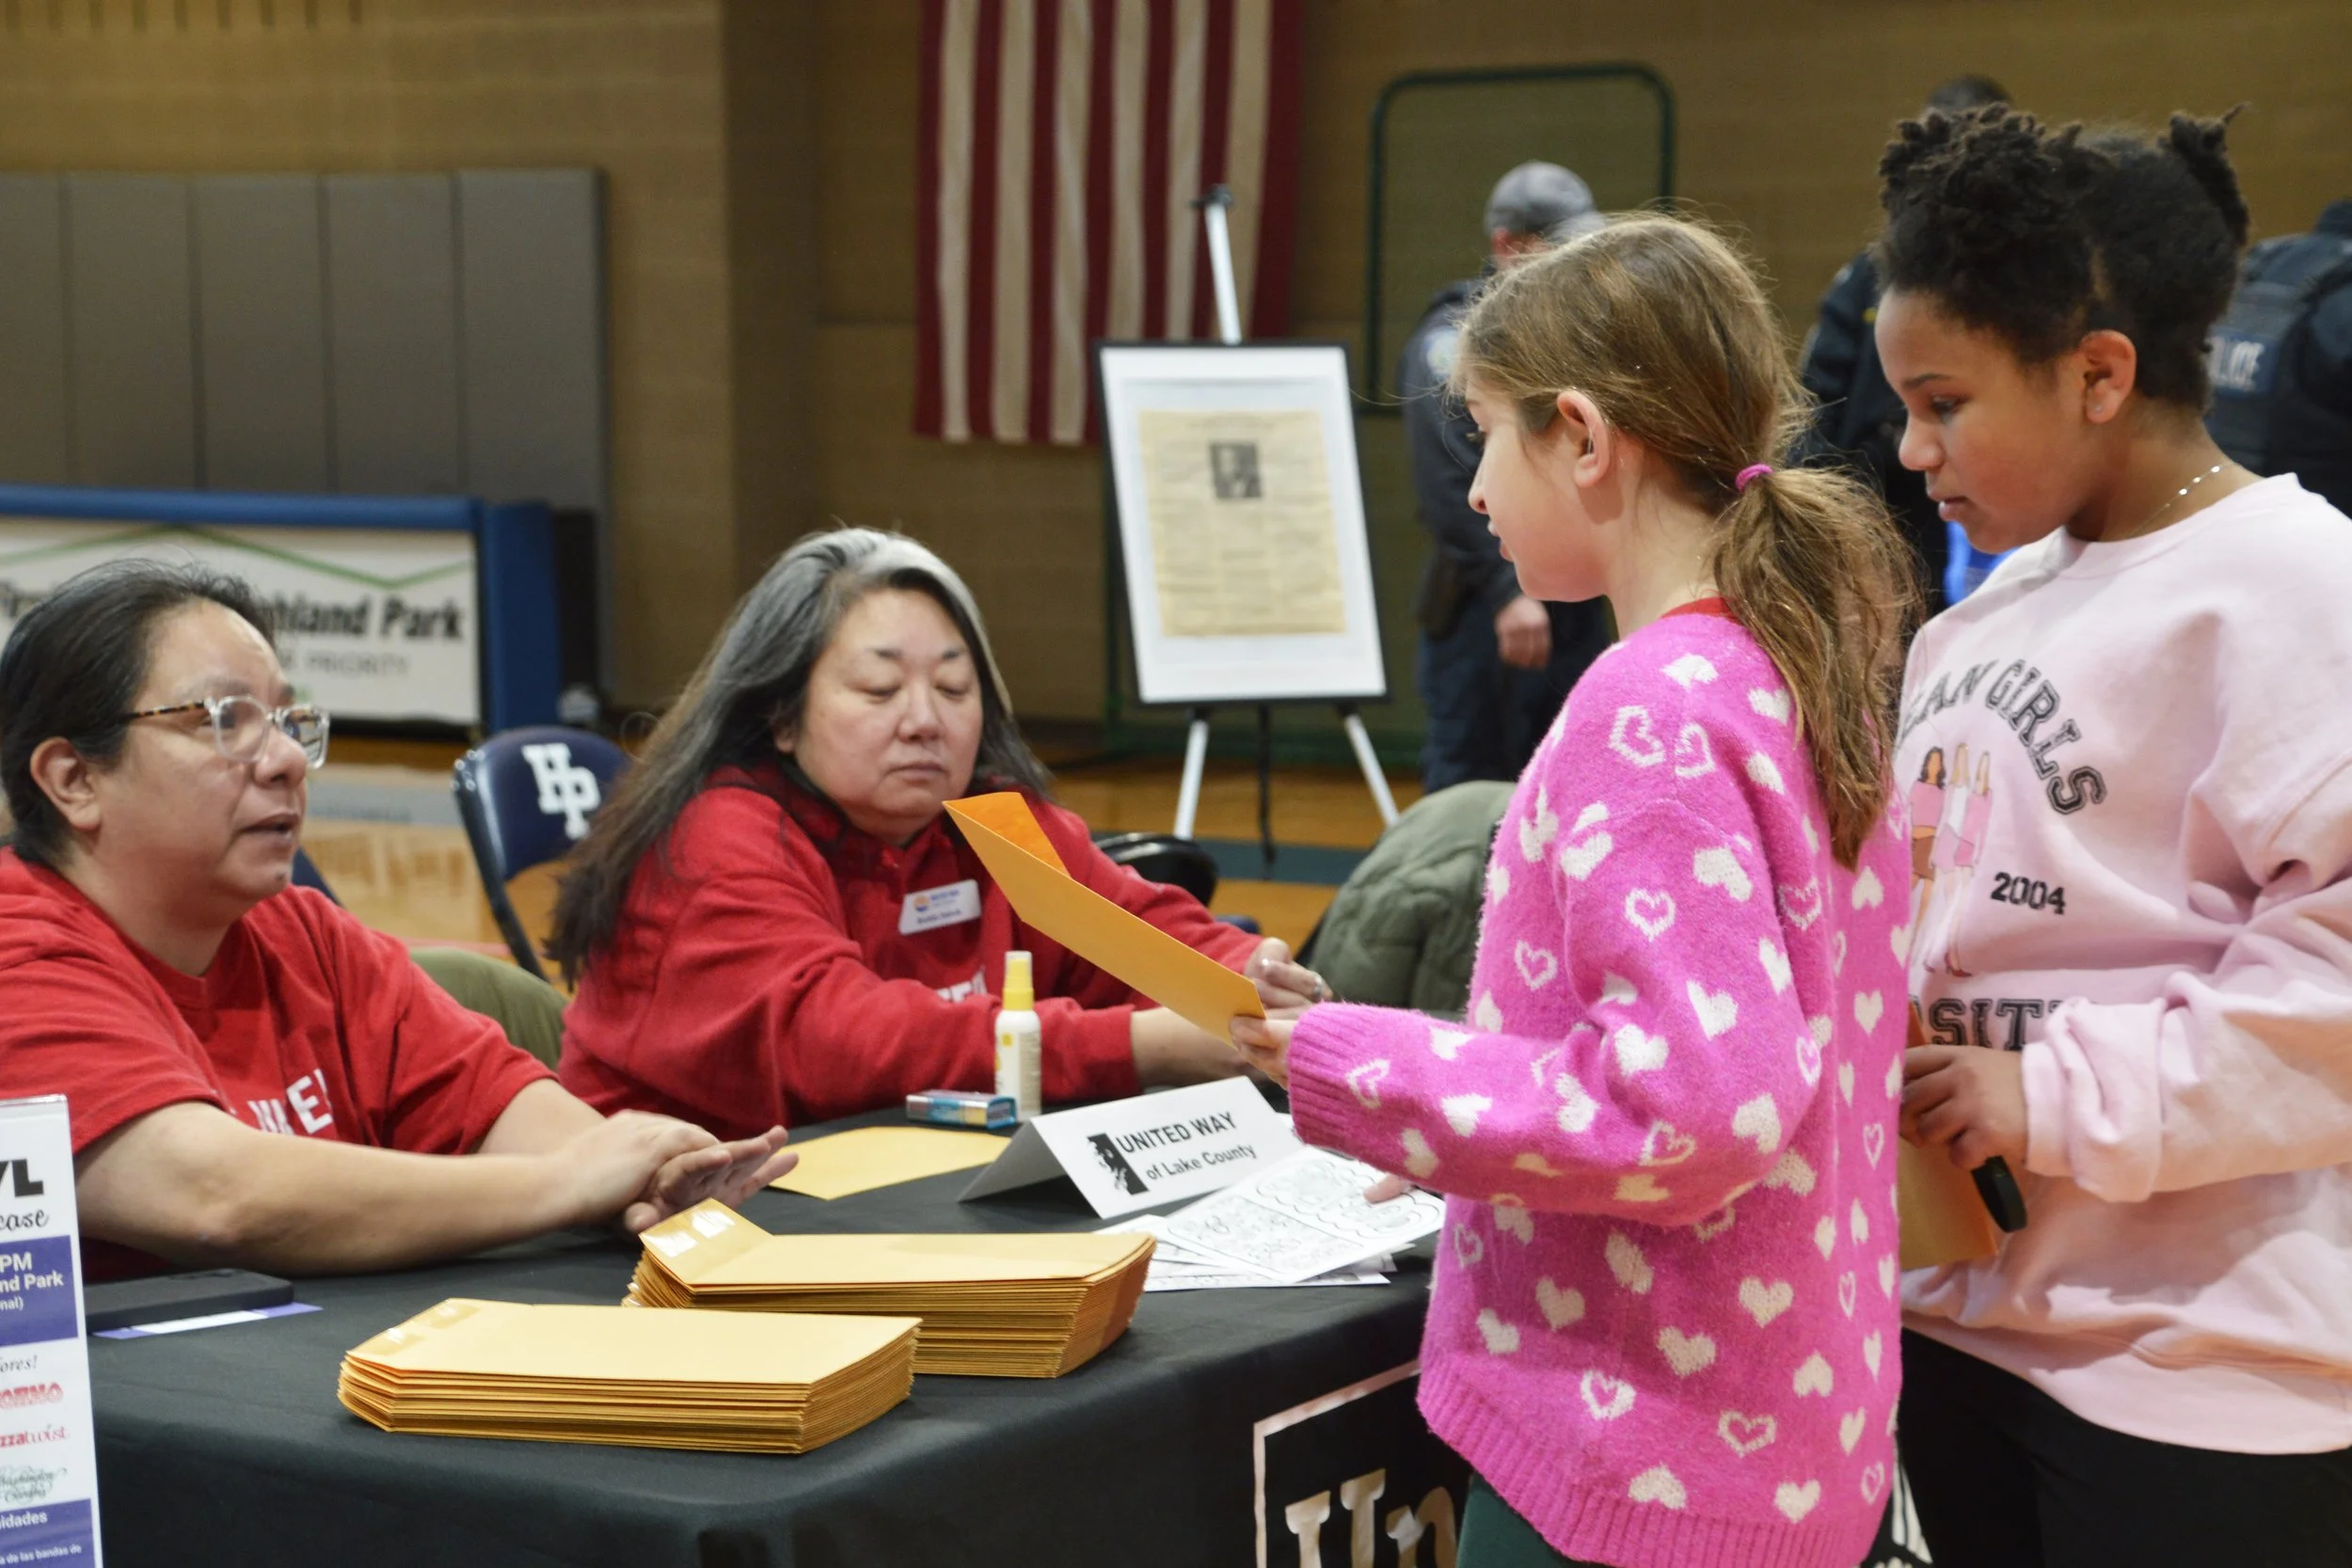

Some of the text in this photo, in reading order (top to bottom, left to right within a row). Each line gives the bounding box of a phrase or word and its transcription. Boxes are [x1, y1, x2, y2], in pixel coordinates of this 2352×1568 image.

[380, 596, 462, 641] Park
[1984, 658, 2107, 815] GIRLS
[1990, 872, 2067, 915] 2004
[1909, 994, 2066, 1052] SIT
[1115, 1111, 1237, 1153] UNITED WAY
[1145, 1144, 1258, 1180] of Lake County
[0, 1252, 33, 1274] PM
[24, 1270, 64, 1290] Park
[20, 1551, 35, 1561] las
[35, 1546, 70, 1560] bandas
[70, 1544, 82, 1554] de
